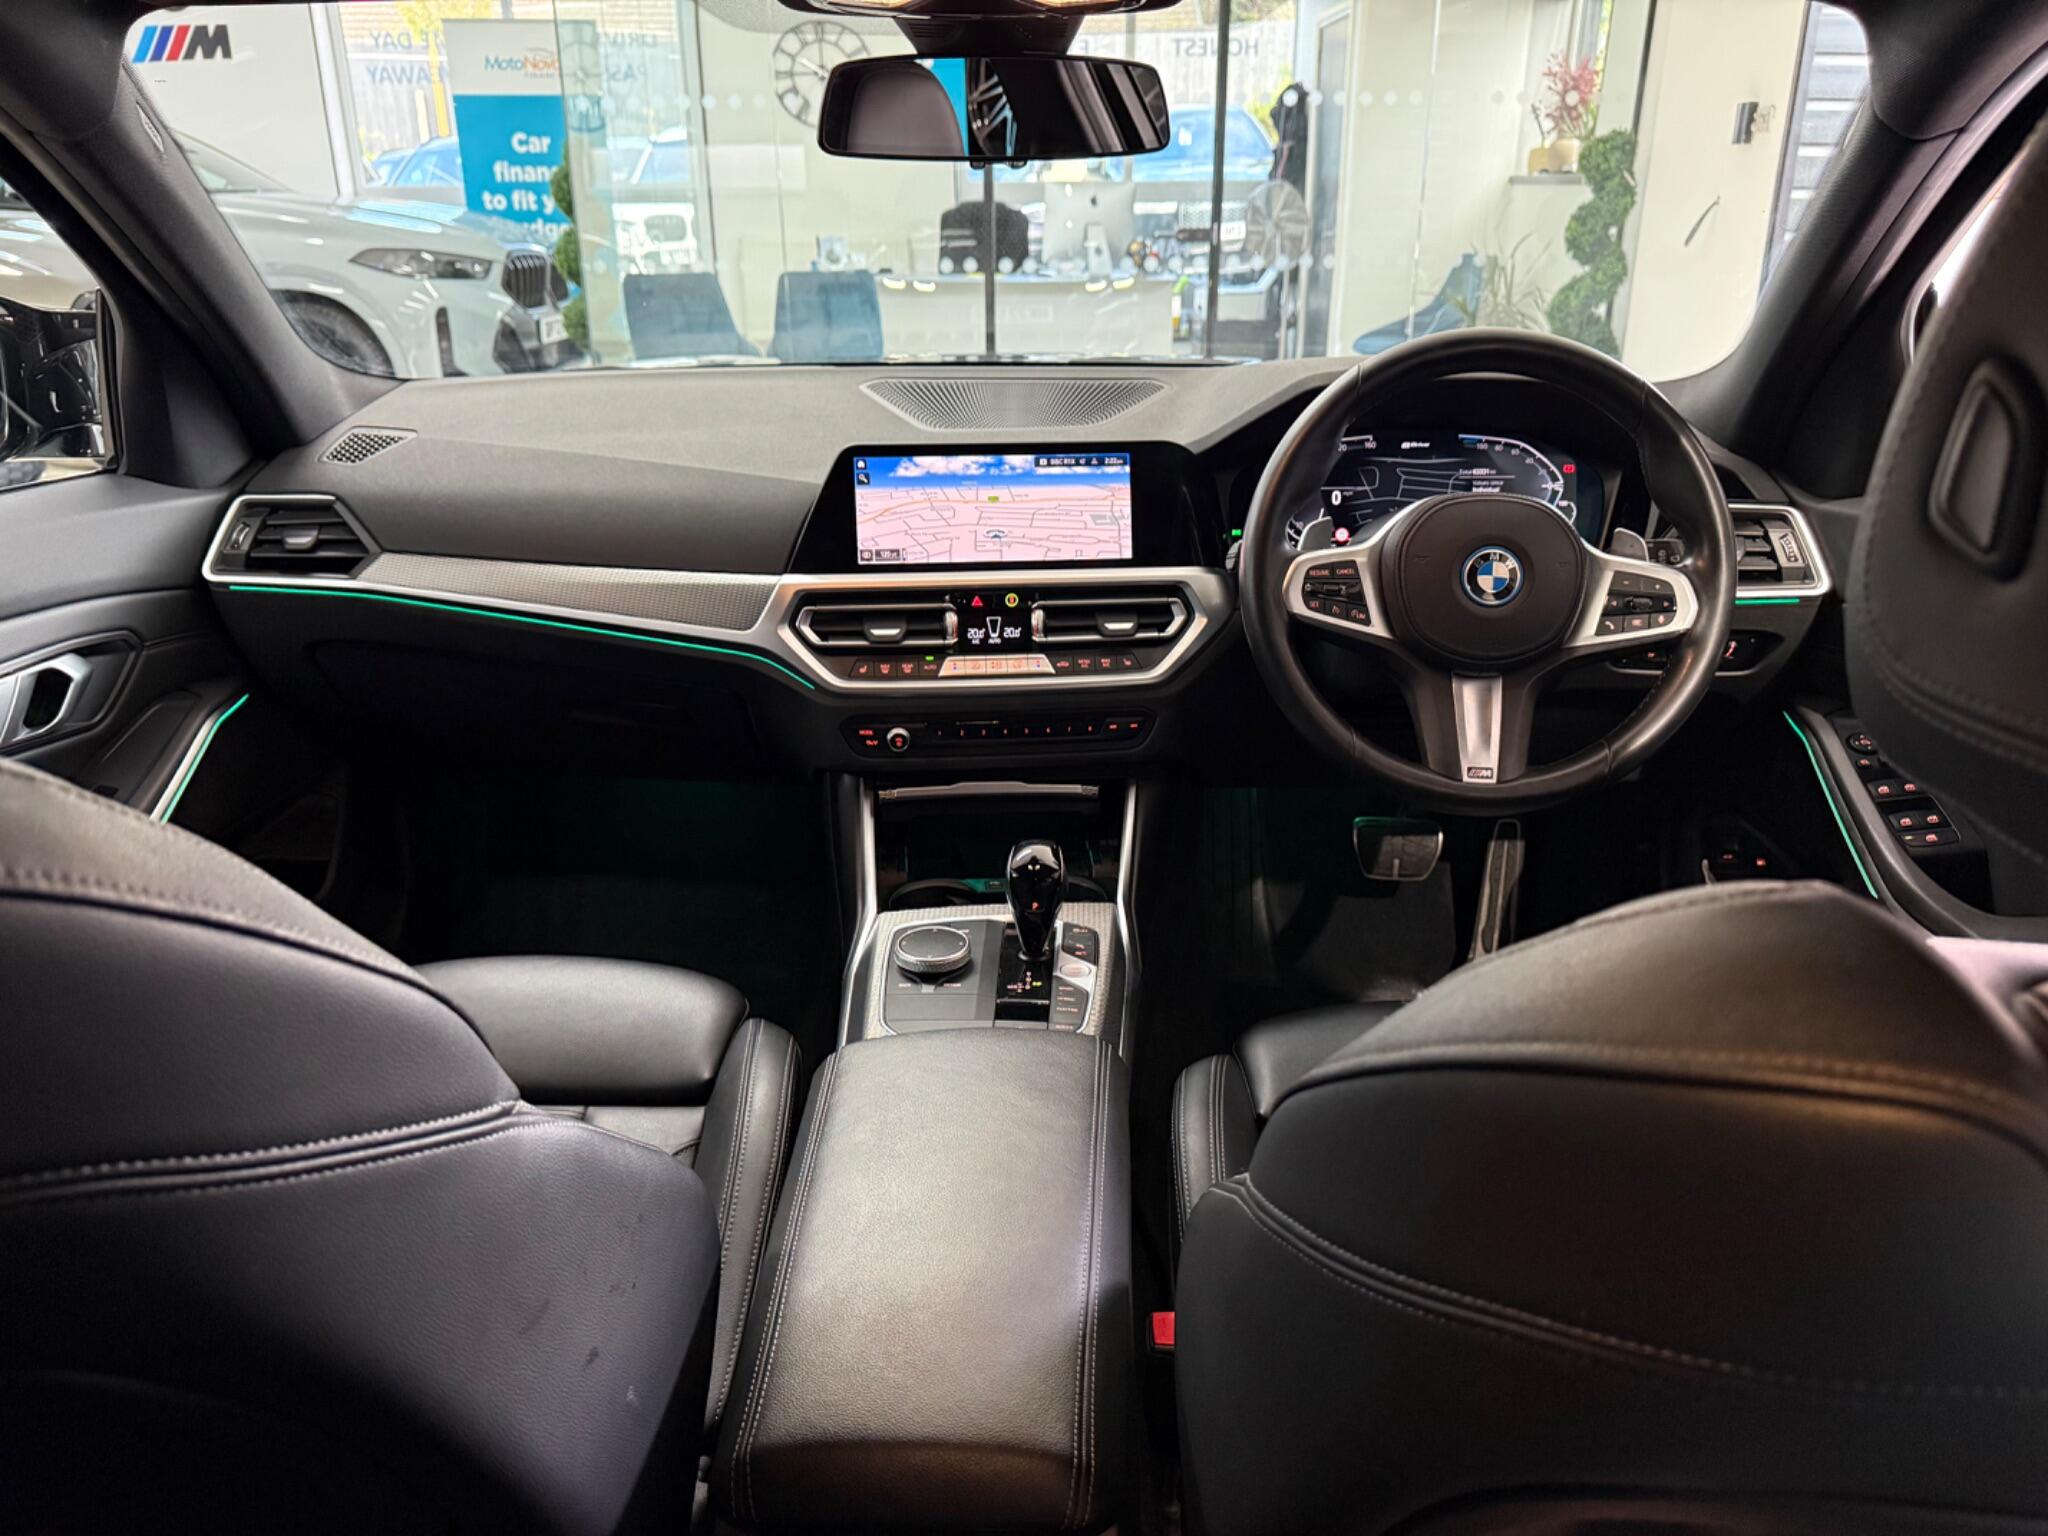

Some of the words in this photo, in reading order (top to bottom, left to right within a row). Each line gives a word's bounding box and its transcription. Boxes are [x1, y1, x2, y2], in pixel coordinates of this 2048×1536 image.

[511, 131, 551, 154] Car
[482, 191, 508, 211] to
[511, 189, 538, 211] fit
[1331, 489, 1342, 506] 0
